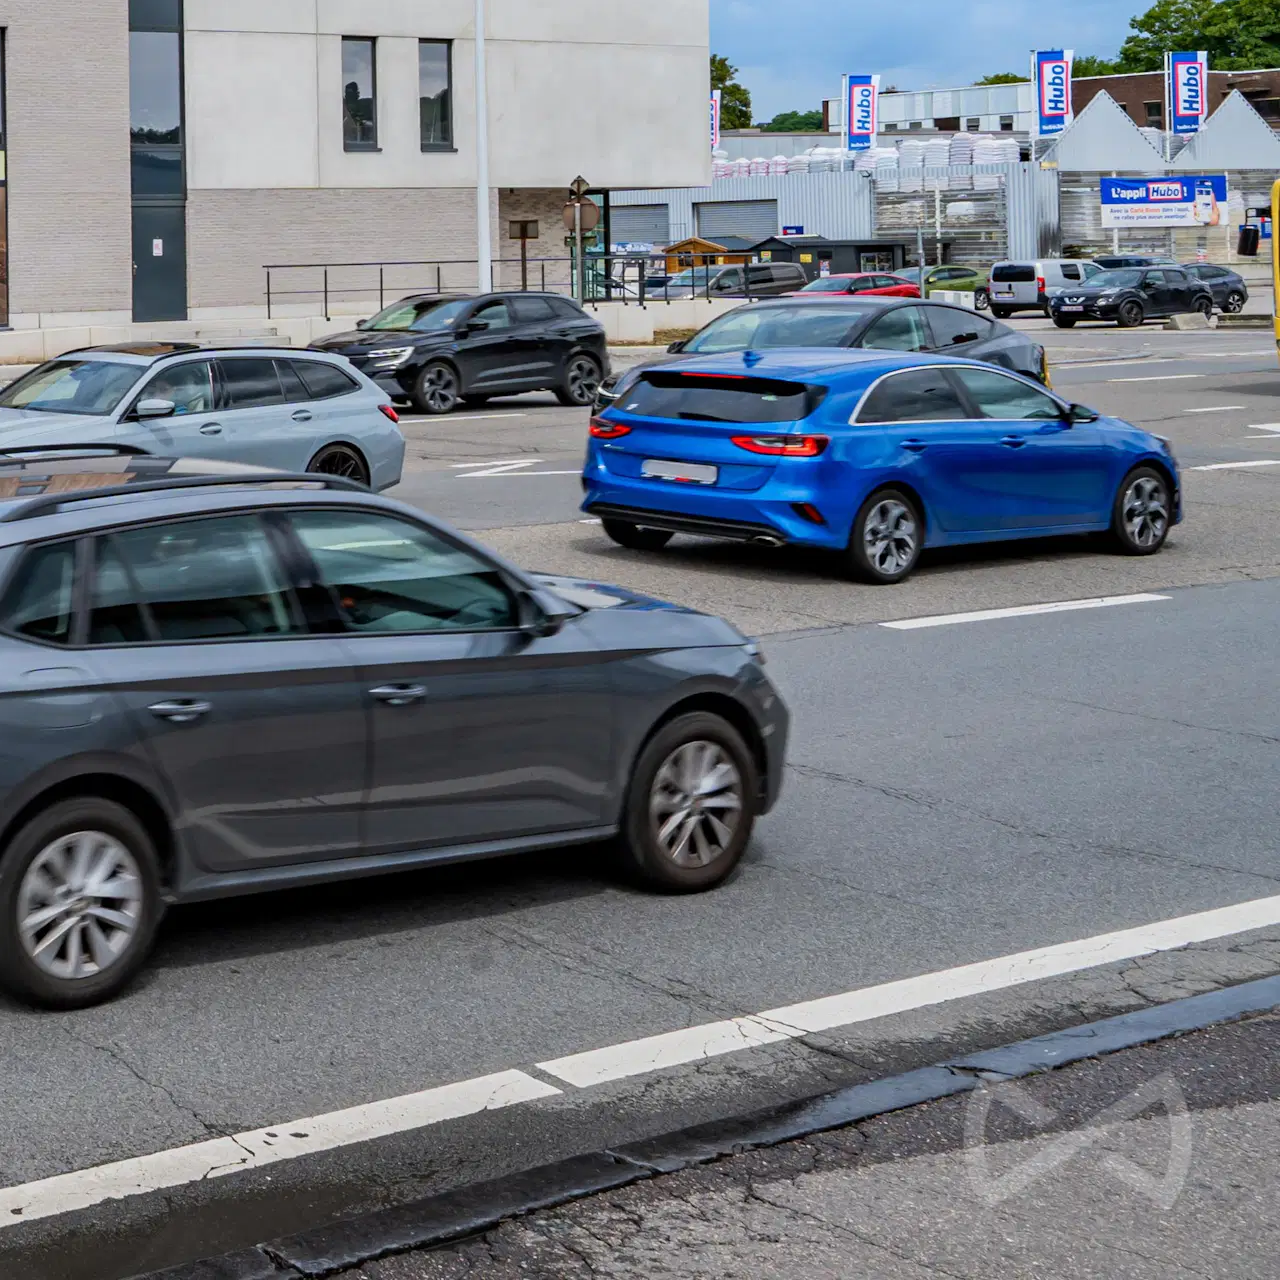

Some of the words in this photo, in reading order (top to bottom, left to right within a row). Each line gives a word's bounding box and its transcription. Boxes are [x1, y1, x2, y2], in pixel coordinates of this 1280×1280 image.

[857, 88, 872, 131] Hubo
[1047, 64, 1065, 112] Hubo
[1183, 66, 1200, 112] Hubo
[1151, 186, 1180, 197] Hubo
